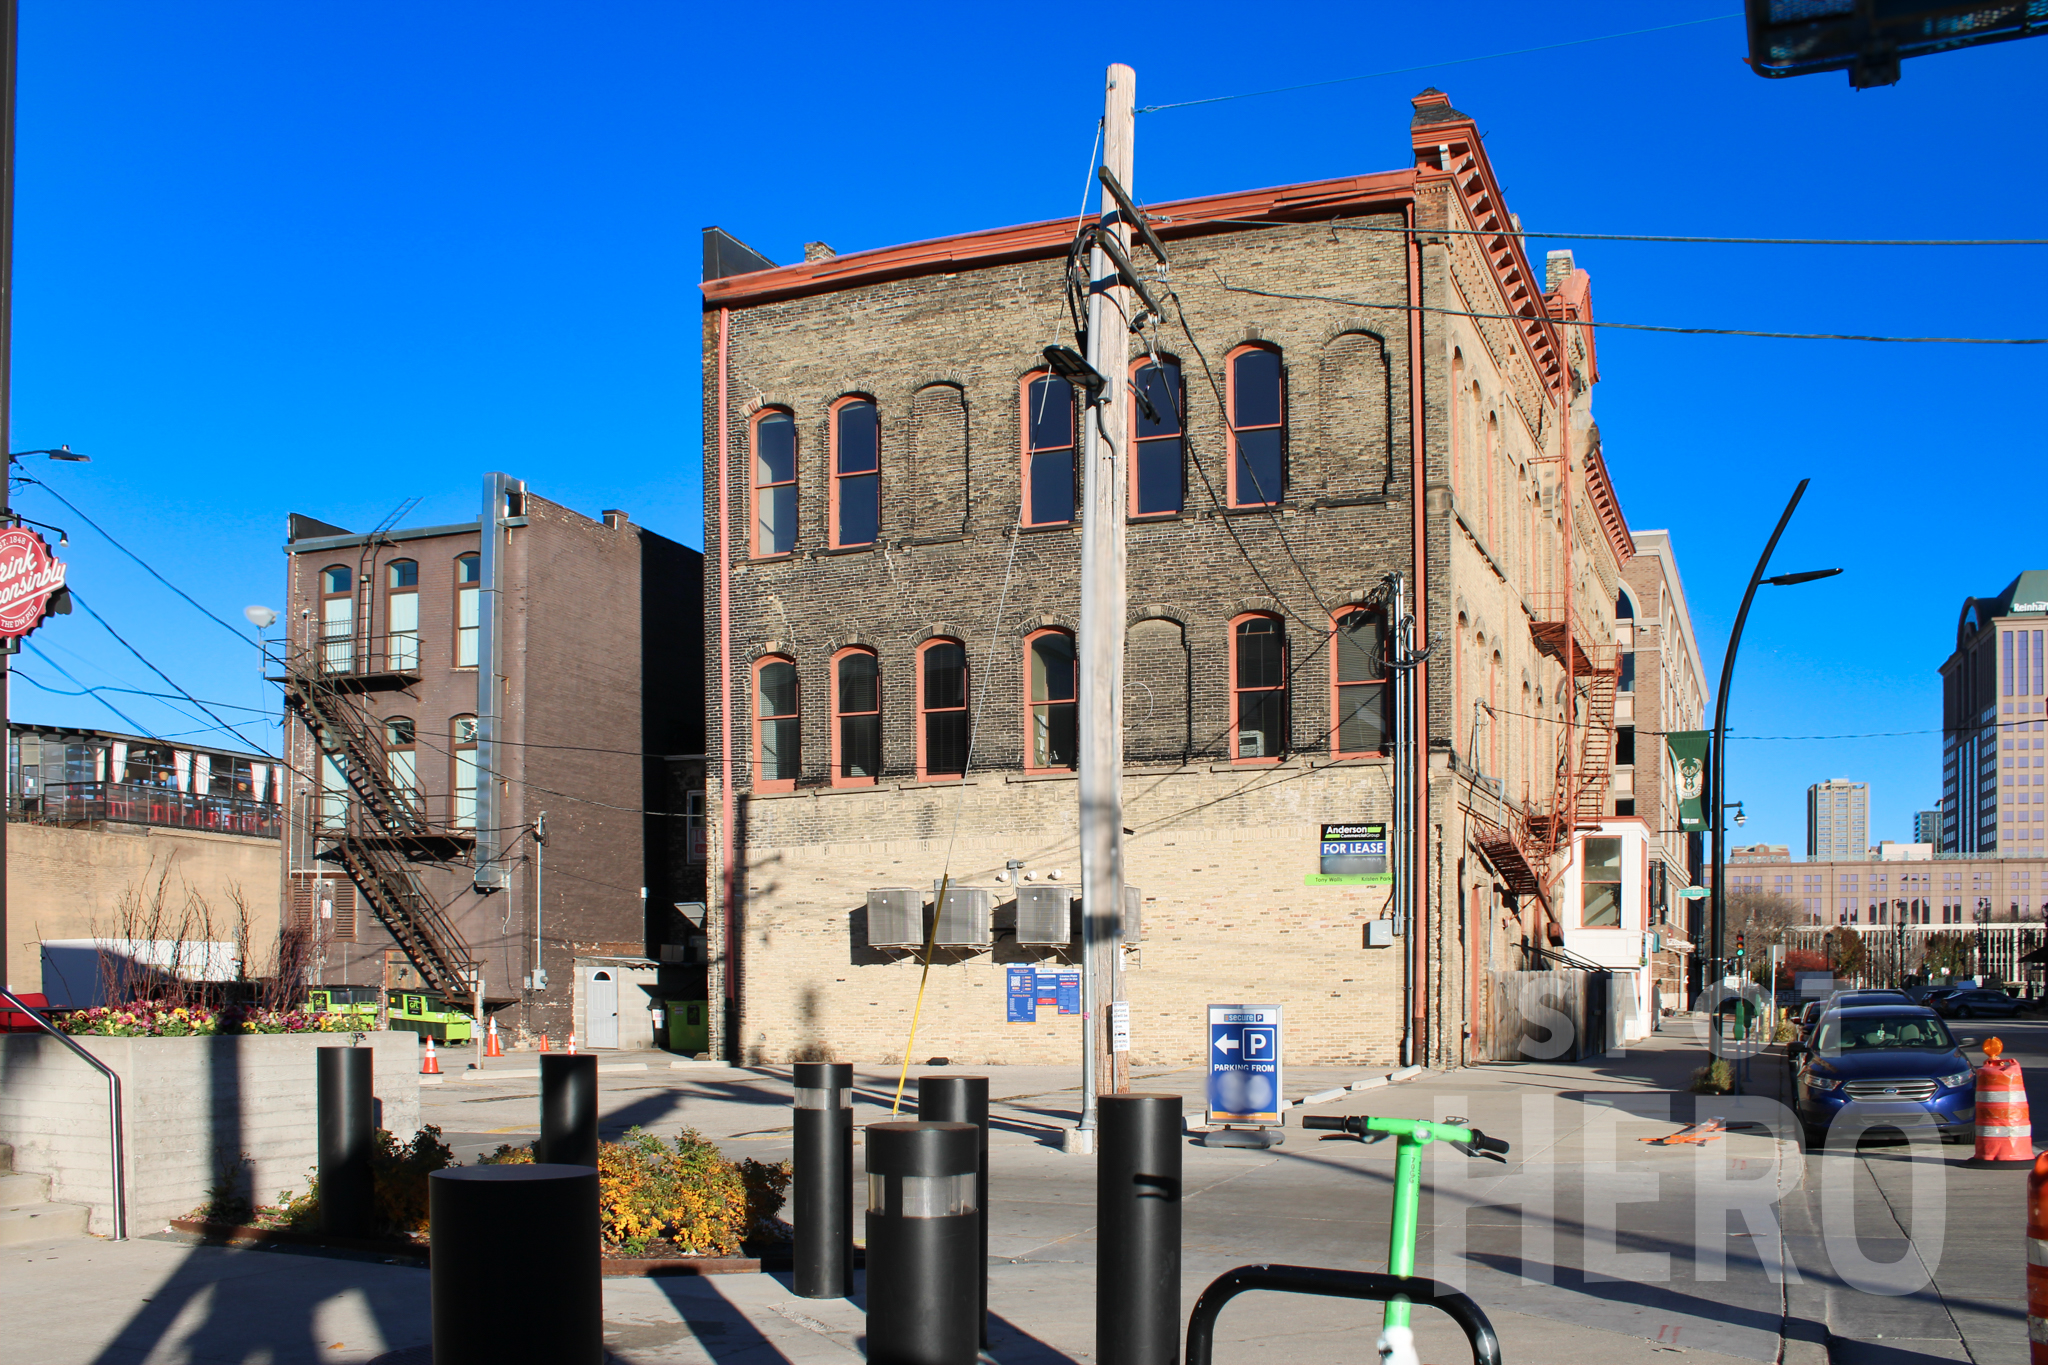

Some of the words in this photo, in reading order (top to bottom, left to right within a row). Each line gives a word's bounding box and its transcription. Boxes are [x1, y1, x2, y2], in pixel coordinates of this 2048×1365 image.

[10, 535, 27, 545] 1848
[0, 557, 67, 605] onsinbly
[1, 619, 14, 629] THE
[15, 617, 26, 628] DW
[26, 605, 38, 621] PUB
[1326, 826, 1367, 834] Anderson
[1323, 843, 1347, 854] FOR
[1349, 842, 1384, 854] LEASE
[1250, 1033, 1267, 1055] P
[1214, 1063, 1249, 1072] PARKING
[1251, 1064, 1275, 1073] FROM
